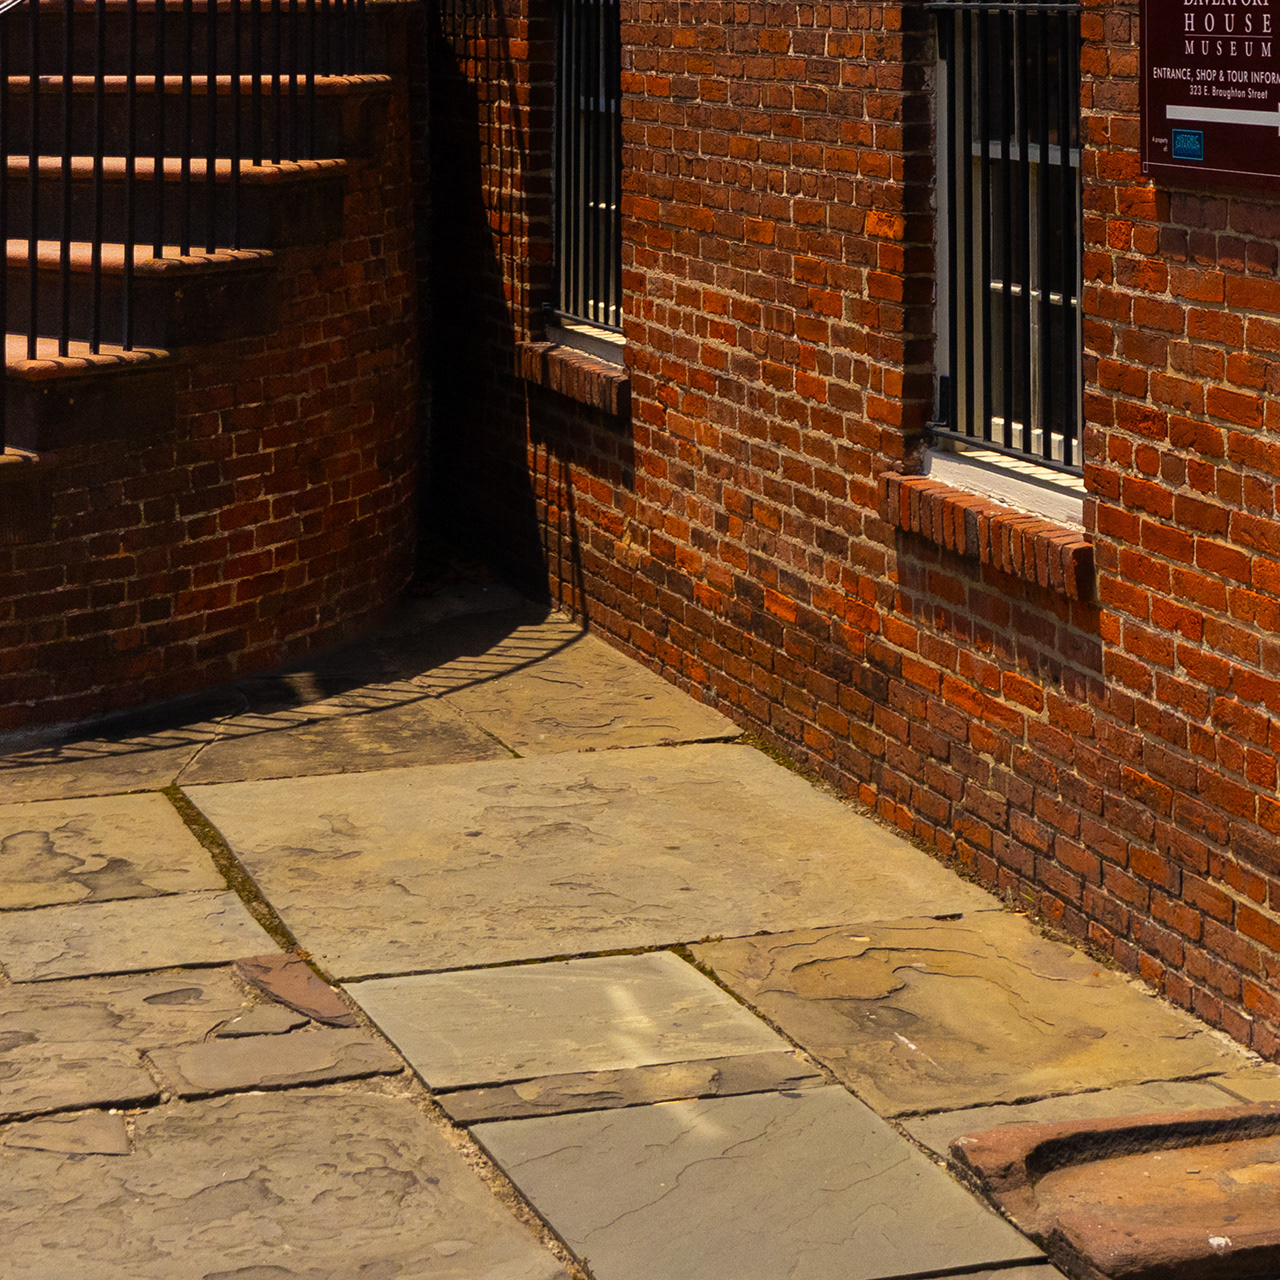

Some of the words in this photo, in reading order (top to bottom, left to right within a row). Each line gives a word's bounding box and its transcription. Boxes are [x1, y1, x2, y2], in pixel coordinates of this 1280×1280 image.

[1185, 13, 1272, 33] HOUSE
[1185, 40, 1272, 57] MUSEUM
[1153, 67, 1194, 82] ENTRANCE,
[1196, 69, 1216, 81] SHOP
[1219, 70, 1225, 82] &
[1227, 70, 1248, 83] TOUR
[1190, 85, 1202, 95] 323
[1204, 86, 1210, 96] E.
[1212, 86, 1246, 100] Broughton
[1248, 88, 1268, 99] Street
